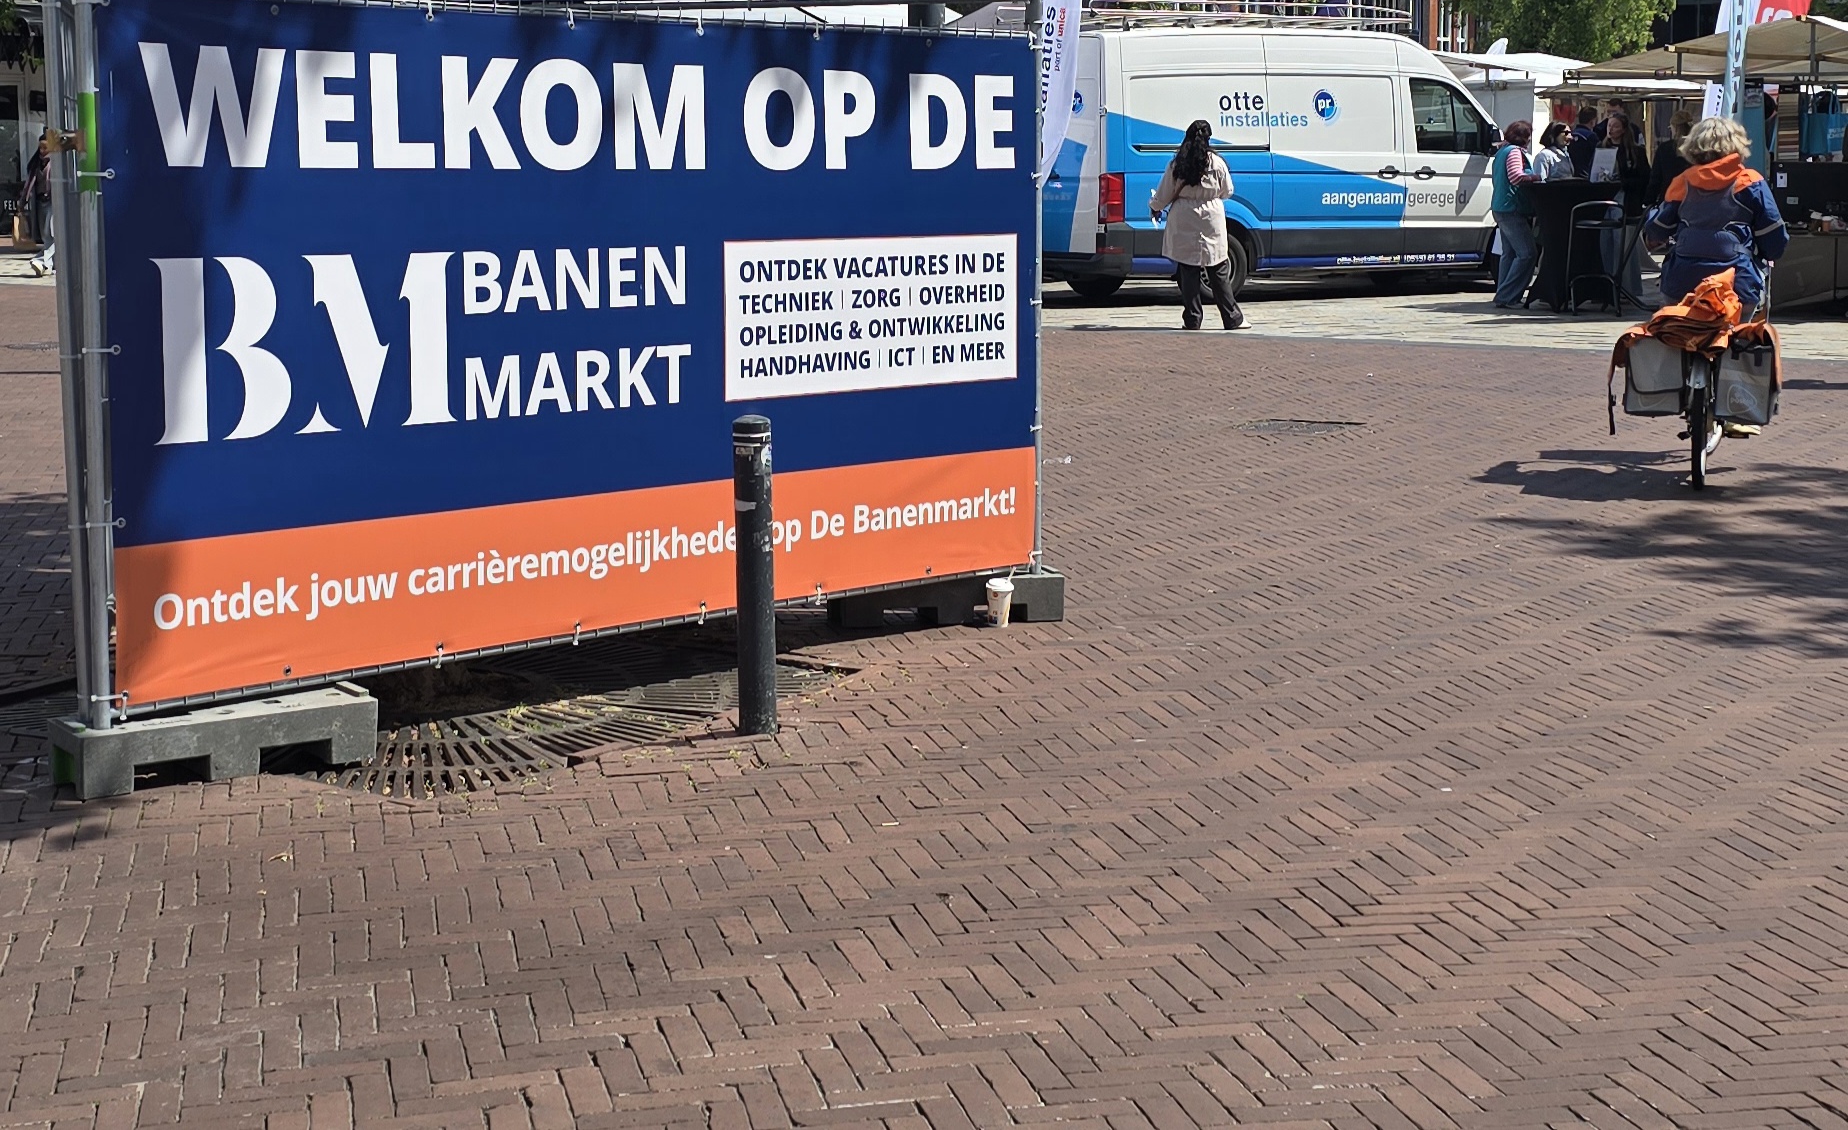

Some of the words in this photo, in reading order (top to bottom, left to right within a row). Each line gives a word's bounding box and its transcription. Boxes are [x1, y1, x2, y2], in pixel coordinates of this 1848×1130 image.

[1057, 7, 1067, 37] unica
[1055, 38, 1063, 48] of
[138, 42, 705, 170] WELKOM
[744, 68, 875, 170] OP
[909, 74, 1015, 169] DE
[1219, 92, 1264, 111] otte
[1317, 98, 1332, 111] pr
[1220, 112, 1308, 127] installaties
[1322, 192, 1404, 208] aangenaam
[1408, 190, 1470, 208] geregeld.
[463, 246, 685, 314] BANEN
[739, 257, 828, 283] ONTDEK
[833, 253, 949, 280] VACATURES
[955, 253, 976, 274] IN
[982, 252, 1005, 273] DE
[739, 290, 834, 315] TECHNIEK
[851, 288, 901, 309] ZORG
[919, 283, 1005, 306] OVERHEID
[739, 321, 843, 347] OPLEIDING
[848, 320, 863, 340] &
[868, 312, 1005, 339] ONTWIKKELING
[150, 252, 457, 445] BM
[740, 350, 871, 378] HANDHAVING
[888, 347, 916, 368] ICT
[932, 345, 955, 364] EN
[960, 341, 1006, 363] MEER
[466, 344, 691, 420] MARKT
[154, 577, 299, 630] Ontdek
[307, 570, 398, 621] jouw
[408, 520, 736, 598] carrièremogelijkhede
[772, 518, 802, 553] op
[811, 510, 845, 540] De
[854, 487, 1015, 534] Banenmarkt!
